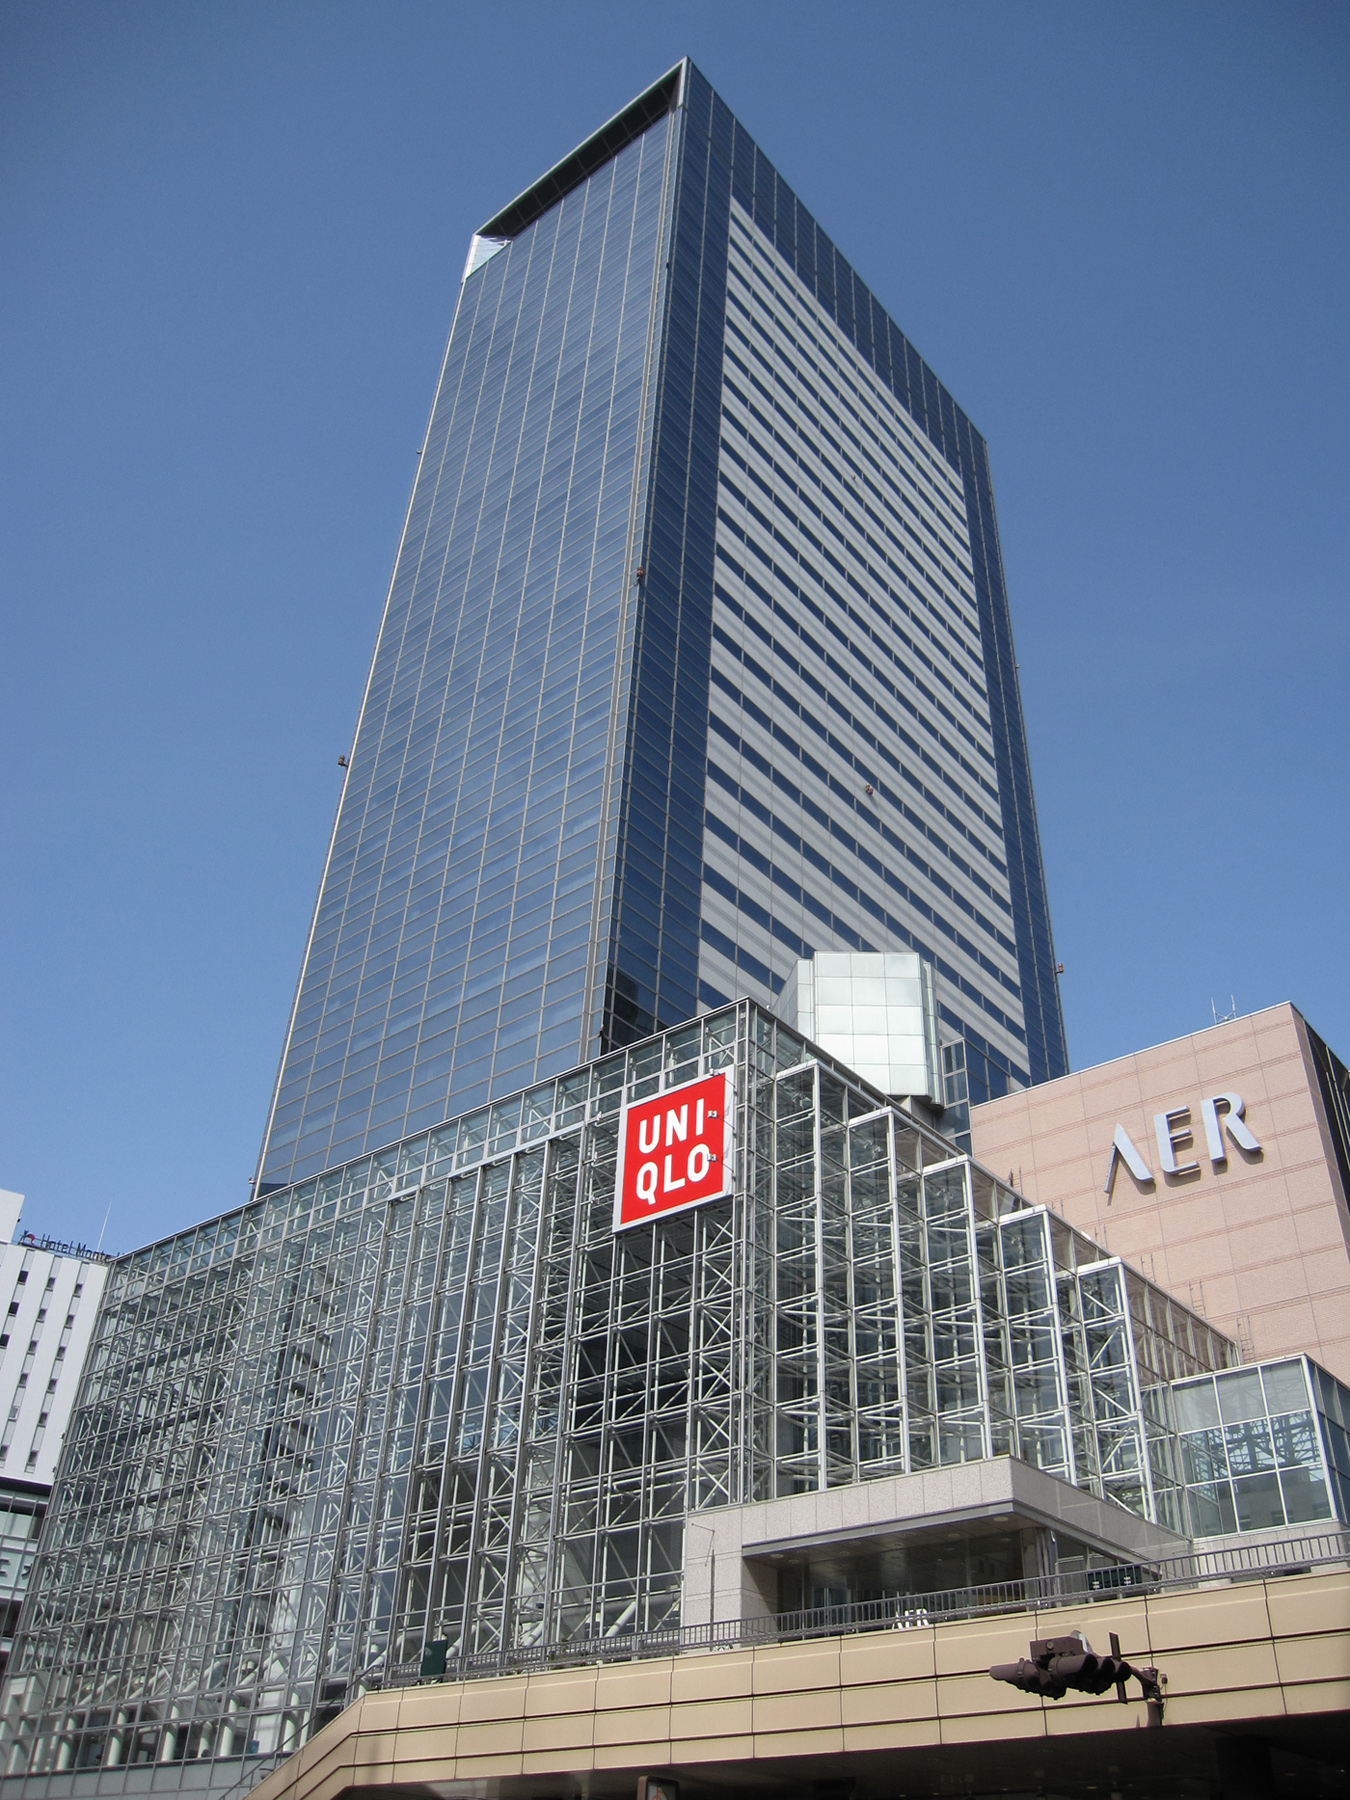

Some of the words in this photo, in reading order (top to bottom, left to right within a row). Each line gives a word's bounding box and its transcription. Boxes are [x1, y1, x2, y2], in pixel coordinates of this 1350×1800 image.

[638, 1098, 704, 1154] UNI
[1103, 1092, 1261, 1194] AER
[636, 1143, 710, 1206] QLO
[41, 1234, 73, 1255] Hotel
